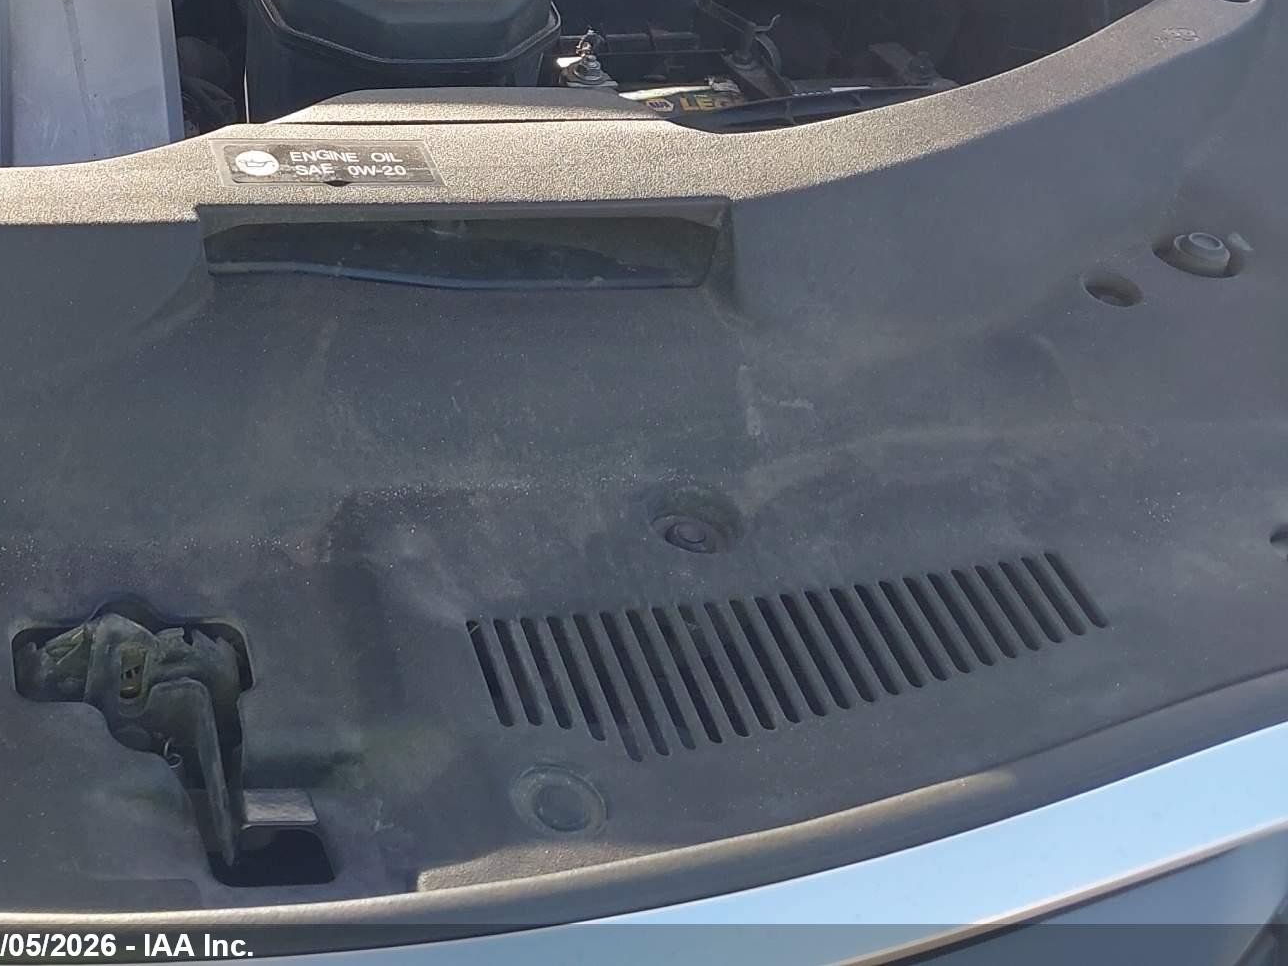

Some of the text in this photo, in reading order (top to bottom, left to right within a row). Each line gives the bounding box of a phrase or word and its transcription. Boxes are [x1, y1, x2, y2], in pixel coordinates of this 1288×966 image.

[290, 149, 403, 163] ENGINE OIL
[295, 163, 407, 176] SAE 0W-20
